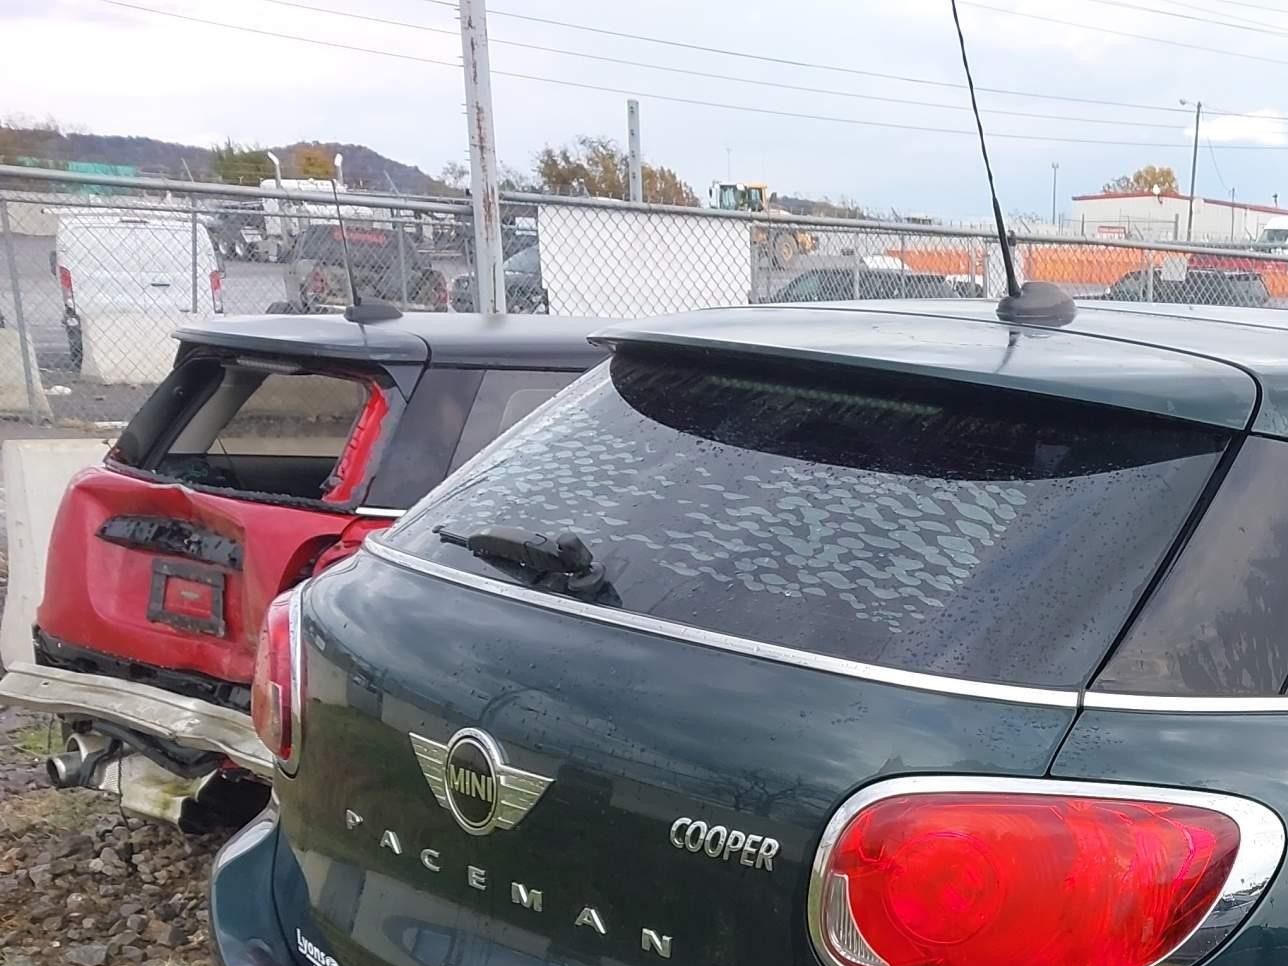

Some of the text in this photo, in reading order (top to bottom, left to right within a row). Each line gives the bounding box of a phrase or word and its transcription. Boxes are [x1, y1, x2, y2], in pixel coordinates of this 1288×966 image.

[449, 763, 492, 803] MINI
[670, 817, 780, 872] COOPER
[345, 808, 673, 959] PACEMAN
[296, 927, 326, 966] Lyons
